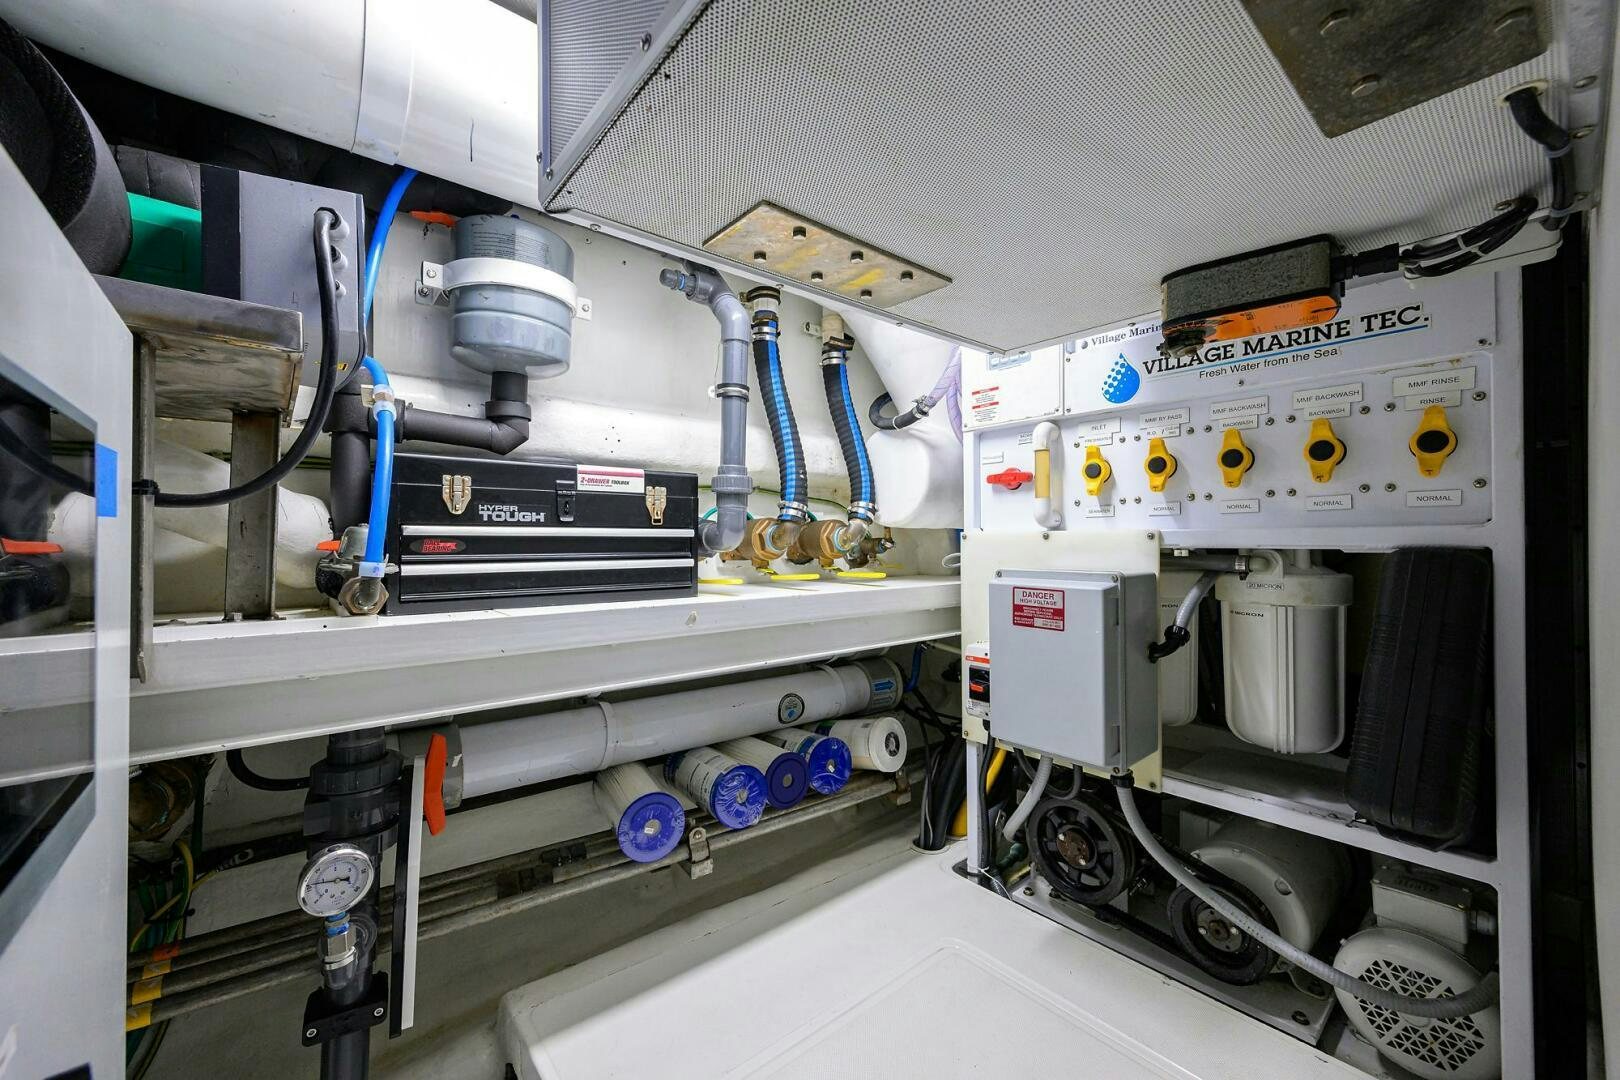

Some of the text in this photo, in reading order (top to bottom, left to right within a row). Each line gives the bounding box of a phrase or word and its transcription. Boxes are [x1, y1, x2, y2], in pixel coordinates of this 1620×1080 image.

[1091, 324, 1162, 346] Village Marin
[1142, 304, 1430, 375] VILLAGE MARINE TEC.
[1199, 347, 1338, 379] Fresh Water from the Sea
[1408, 376, 1461, 388] MMF RINSE
[1296, 389, 1360, 404] MMF BACKWASH
[1420, 396, 1447, 405] RINSE
[1228, 402, 1266, 413] BACKWASH
[1308, 407, 1345, 417] BACKWASH
[479, 504, 519, 512] HYPER
[479, 510, 546, 522] TOUGH
[1022, 591, 1055, 600] DANGER
